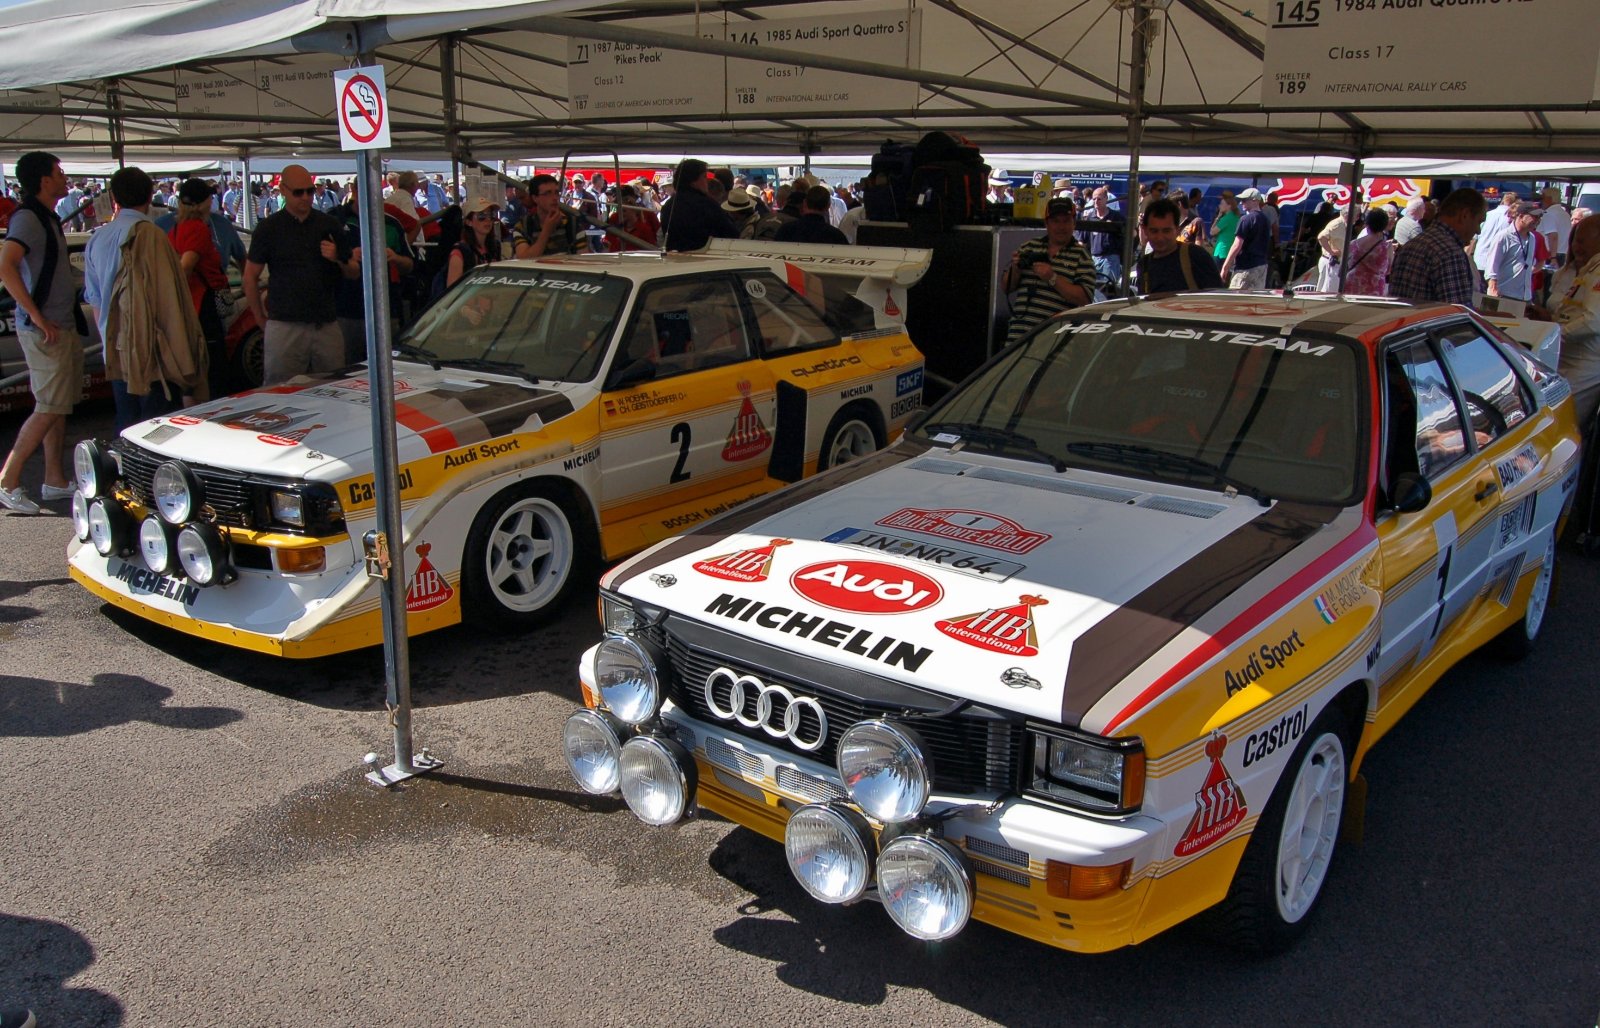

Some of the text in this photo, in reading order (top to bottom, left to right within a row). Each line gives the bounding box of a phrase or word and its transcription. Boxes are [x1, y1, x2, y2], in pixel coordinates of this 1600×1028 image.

[1276, 0, 1321, 24] 145
[766, 31, 792, 42] 1985
[795, 27, 819, 41] Audi
[823, 25, 850, 41] Sport
[853, 21, 895, 37] Quattro
[577, 44, 589, 61] 71
[593, 42, 612, 54] 1987
[1328, 45, 1395, 60] Class 17
[260, 75, 270, 89] 58
[594, 74, 625, 86] Class 12
[766, 65, 806, 78] Class 17
[1275, 72, 1311, 81] SHELTER
[177, 83, 190, 96] 200
[737, 92, 849, 104] 188 INTERNATIONAL RALLY CARS
[1279, 81, 1468, 95] 189 INTERNATIONAL RALLY CARS
[575, 100, 588, 111] 187
[821, 256, 877, 267] TEAM
[464, 276, 603, 295] HB Audi TEAM
[749, 283, 763, 295] 146
[1060, 319, 1336, 358] HB Audi TEAM
[790, 355, 862, 378] quattro
[840, 383, 874, 400] MICHELIN
[898, 371, 921, 392] SKF
[733, 413, 760, 448] HB
[443, 438, 521, 470] Audi Sport
[669, 421, 692, 485] 2
[727, 442, 767, 459] international
[661, 511, 704, 530] BOSCH
[704, 501, 729, 517] fuel
[966, 516, 984, 526] 1
[887, 510, 1039, 550] RALLYE MONTE-CARLO
[720, 548, 770, 575] HB
[852, 534, 999, 575] IN NR 64
[698, 561, 759, 583] international
[115, 562, 201, 607] MICHELIN
[410, 569, 441, 599] HB
[798, 563, 931, 608] Audi
[1429, 543, 1453, 641] 1
[405, 594, 448, 611] international
[1339, 587, 1361, 612] PONS
[704, 593, 934, 674] MICHELIN
[966, 607, 1031, 642] HB
[943, 623, 1027, 656] international
[1223, 630, 1306, 699] Audi Sport
[1242, 703, 1309, 768] Castrol
[1196, 778, 1237, 834] HB
[1181, 814, 1240, 854] international
